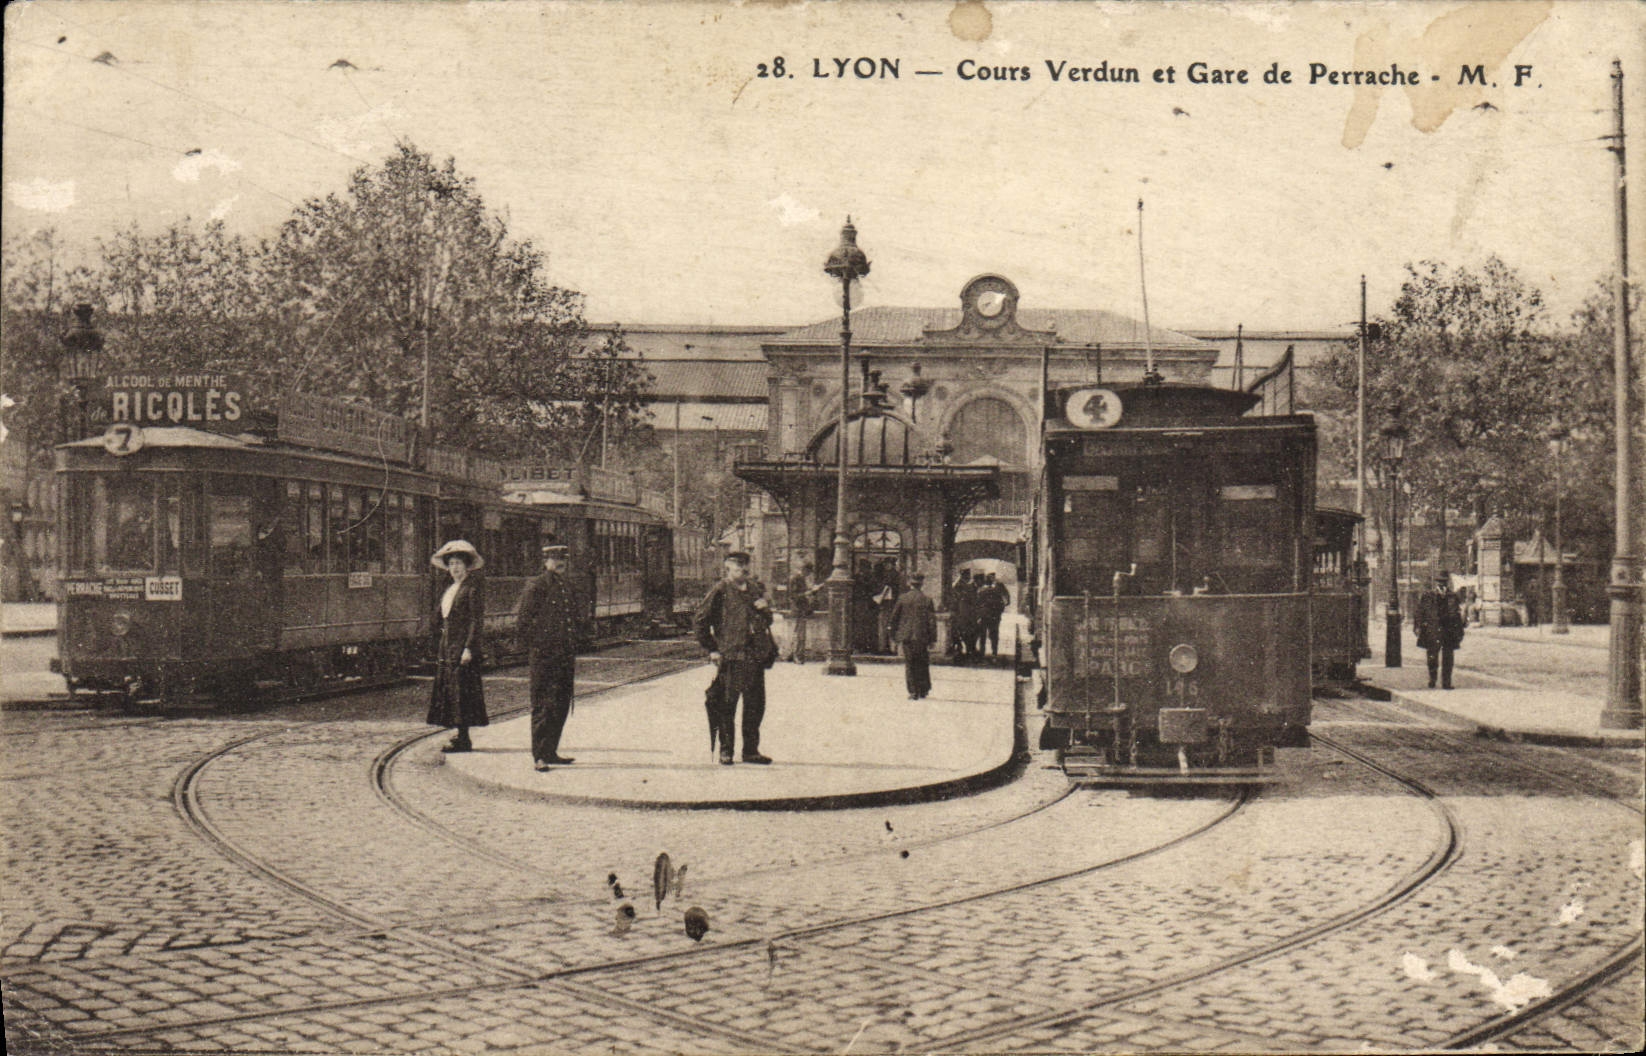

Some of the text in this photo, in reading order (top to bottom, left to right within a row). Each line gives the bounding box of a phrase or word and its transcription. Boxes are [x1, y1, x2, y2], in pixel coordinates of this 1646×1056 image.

[105, 375, 154, 388] ALCOOL
[175, 375, 228, 388] MENTHE
[1082, 394, 1108, 423] 4
[113, 427, 132, 451] 7
[149, 580, 180, 596] CUSSET
